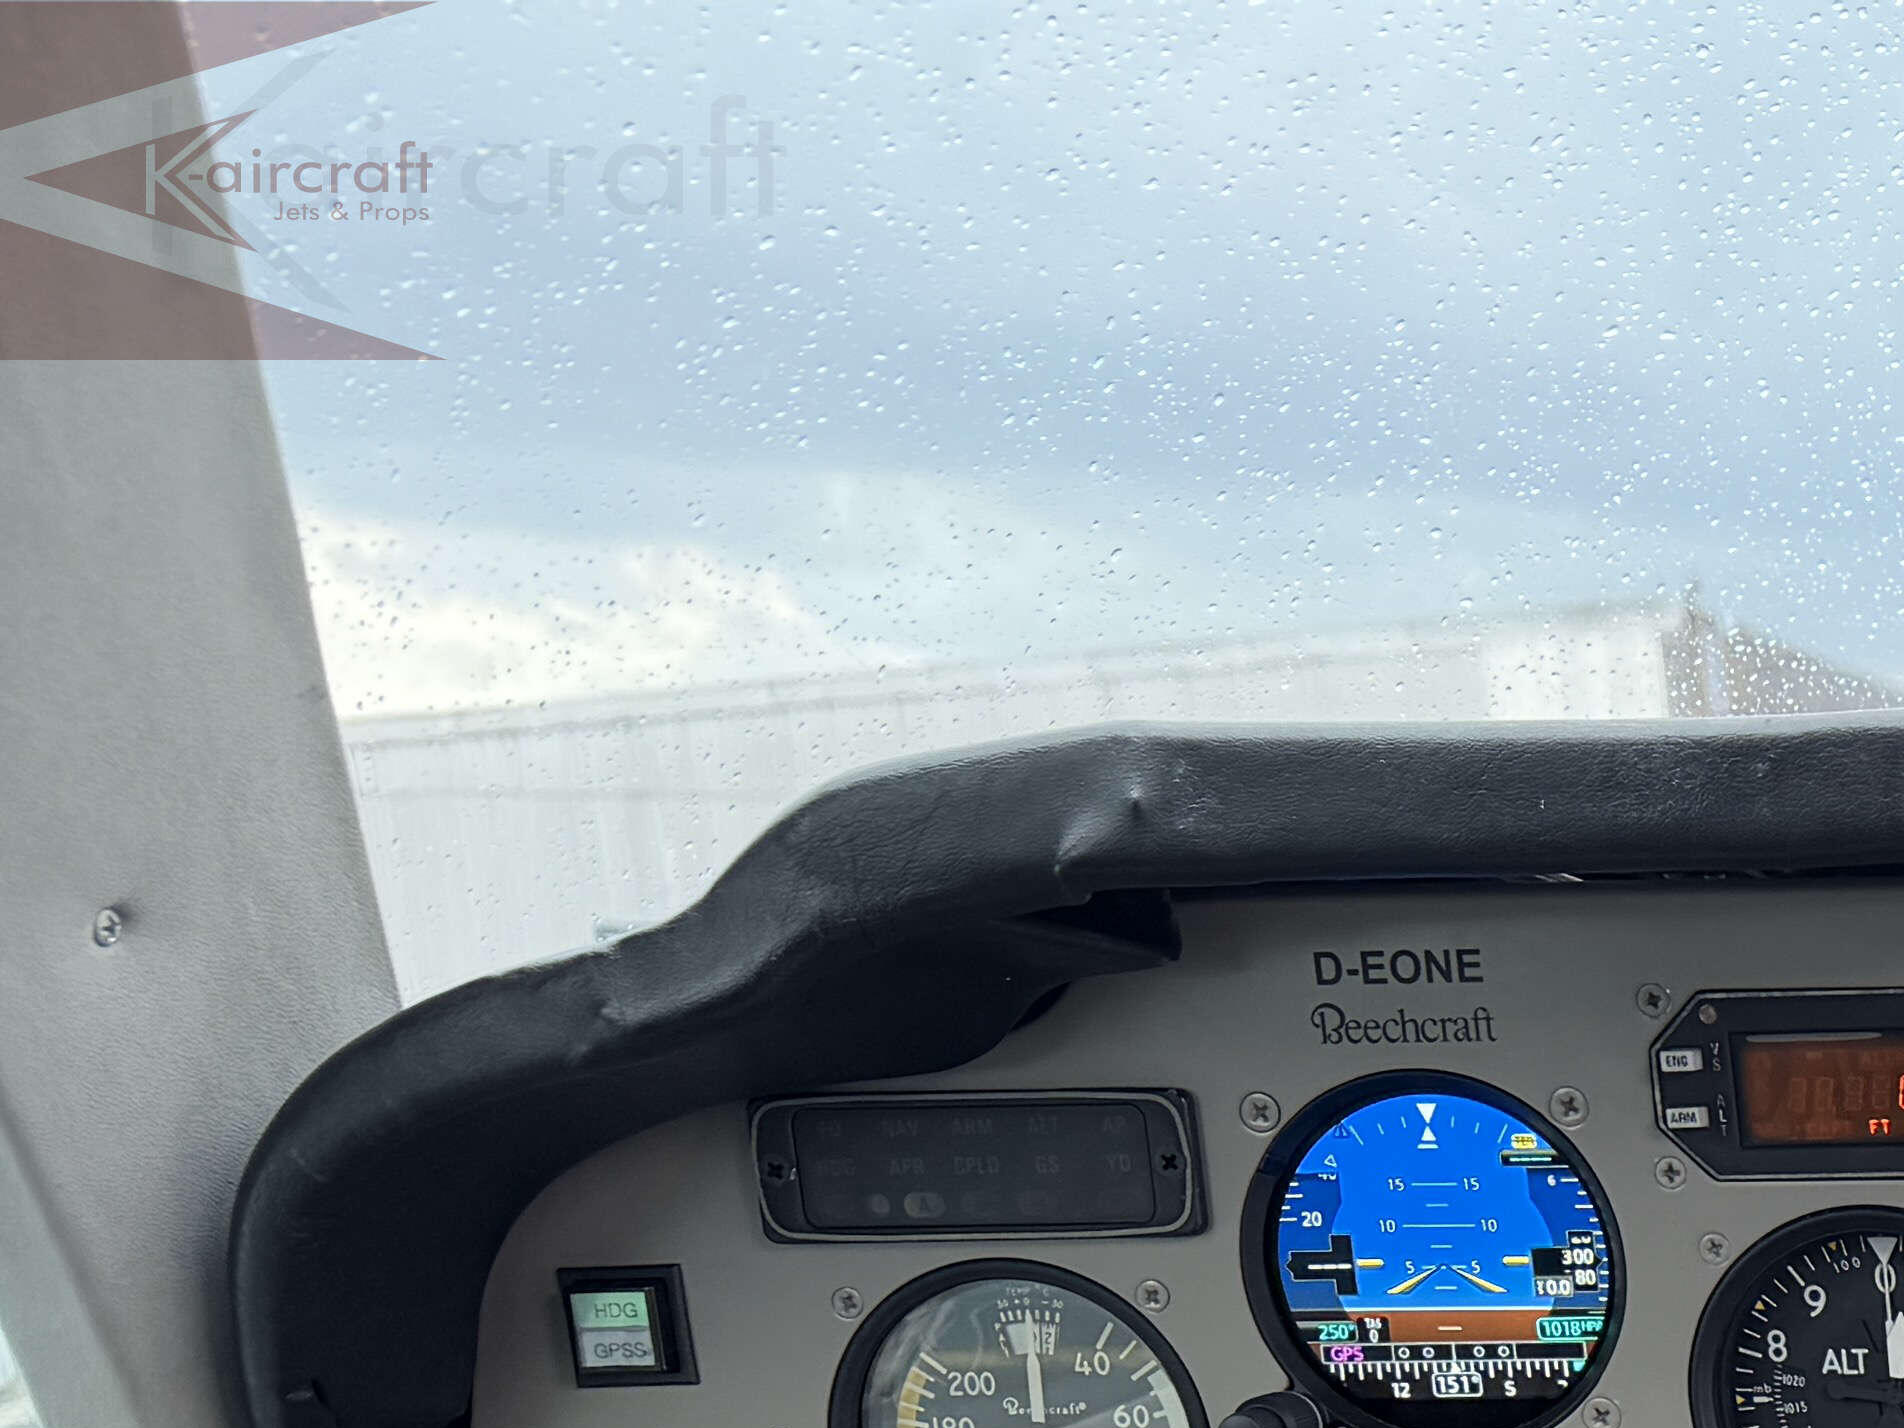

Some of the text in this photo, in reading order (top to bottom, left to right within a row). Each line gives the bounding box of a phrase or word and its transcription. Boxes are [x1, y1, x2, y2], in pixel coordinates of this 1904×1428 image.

[1313, 949, 1485, 985] D-EONE
[1311, 1004, 1498, 1046] Beechcraft
[593, 1302, 638, 1320] HDG
[593, 1341, 648, 1358] GPSS
[1822, 1345, 1870, 1375] ALT
[947, 1371, 995, 1396] 200
